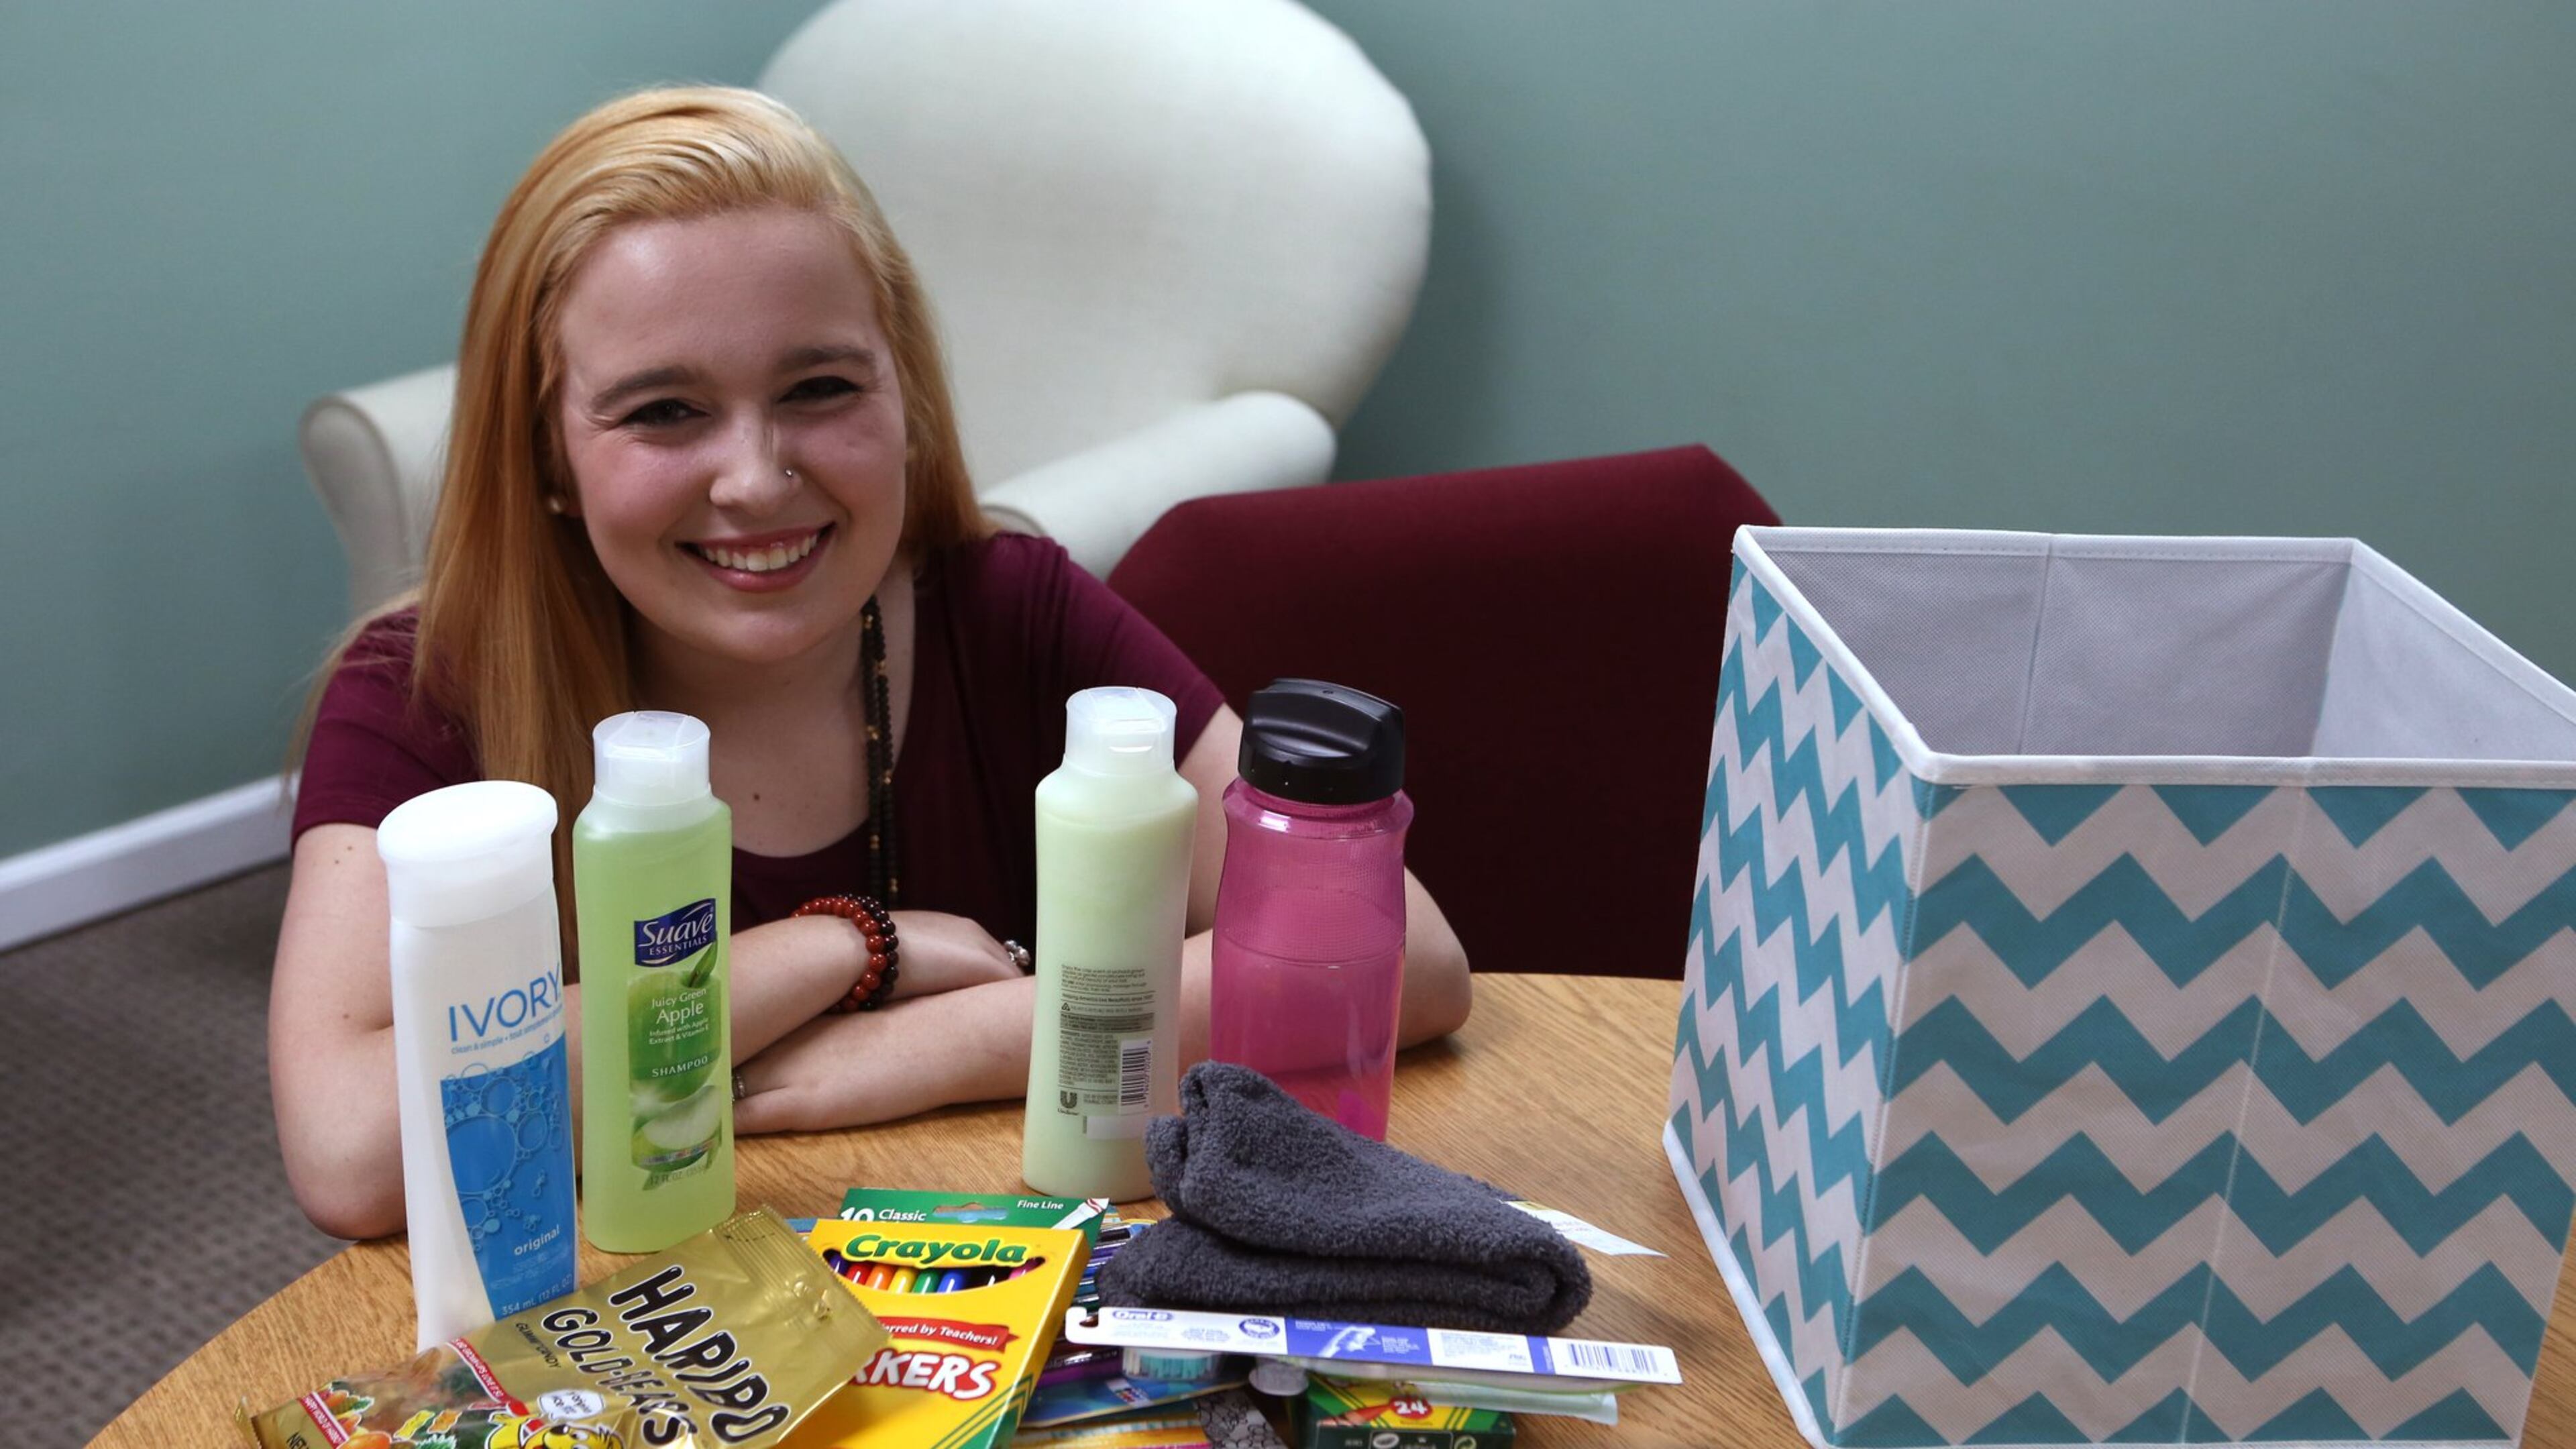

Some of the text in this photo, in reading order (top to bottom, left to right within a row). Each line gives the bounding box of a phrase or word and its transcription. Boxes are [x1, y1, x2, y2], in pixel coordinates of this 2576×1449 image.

[638, 913, 714, 947] Suave
[649, 936, 708, 955] ESSENTIALS
[449, 962, 561, 1042] IVORY
[652, 988, 706, 1009] Juicy Green
[656, 1000, 704, 1027] Apple
[652, 1055, 708, 1077] SHAMPOO
[879, 1209, 926, 1222] Classic
[1017, 1199, 1064, 1210] Fine Line
[514, 1224, 559, 1256] original
[845, 1234, 1027, 1265] Crayola
[502, 1302, 521, 1316] 354
[920, 1324, 937, 1336] by
[939, 1326, 998, 1346] Teachers!
[1393, 1400, 1428, 1415] 24
